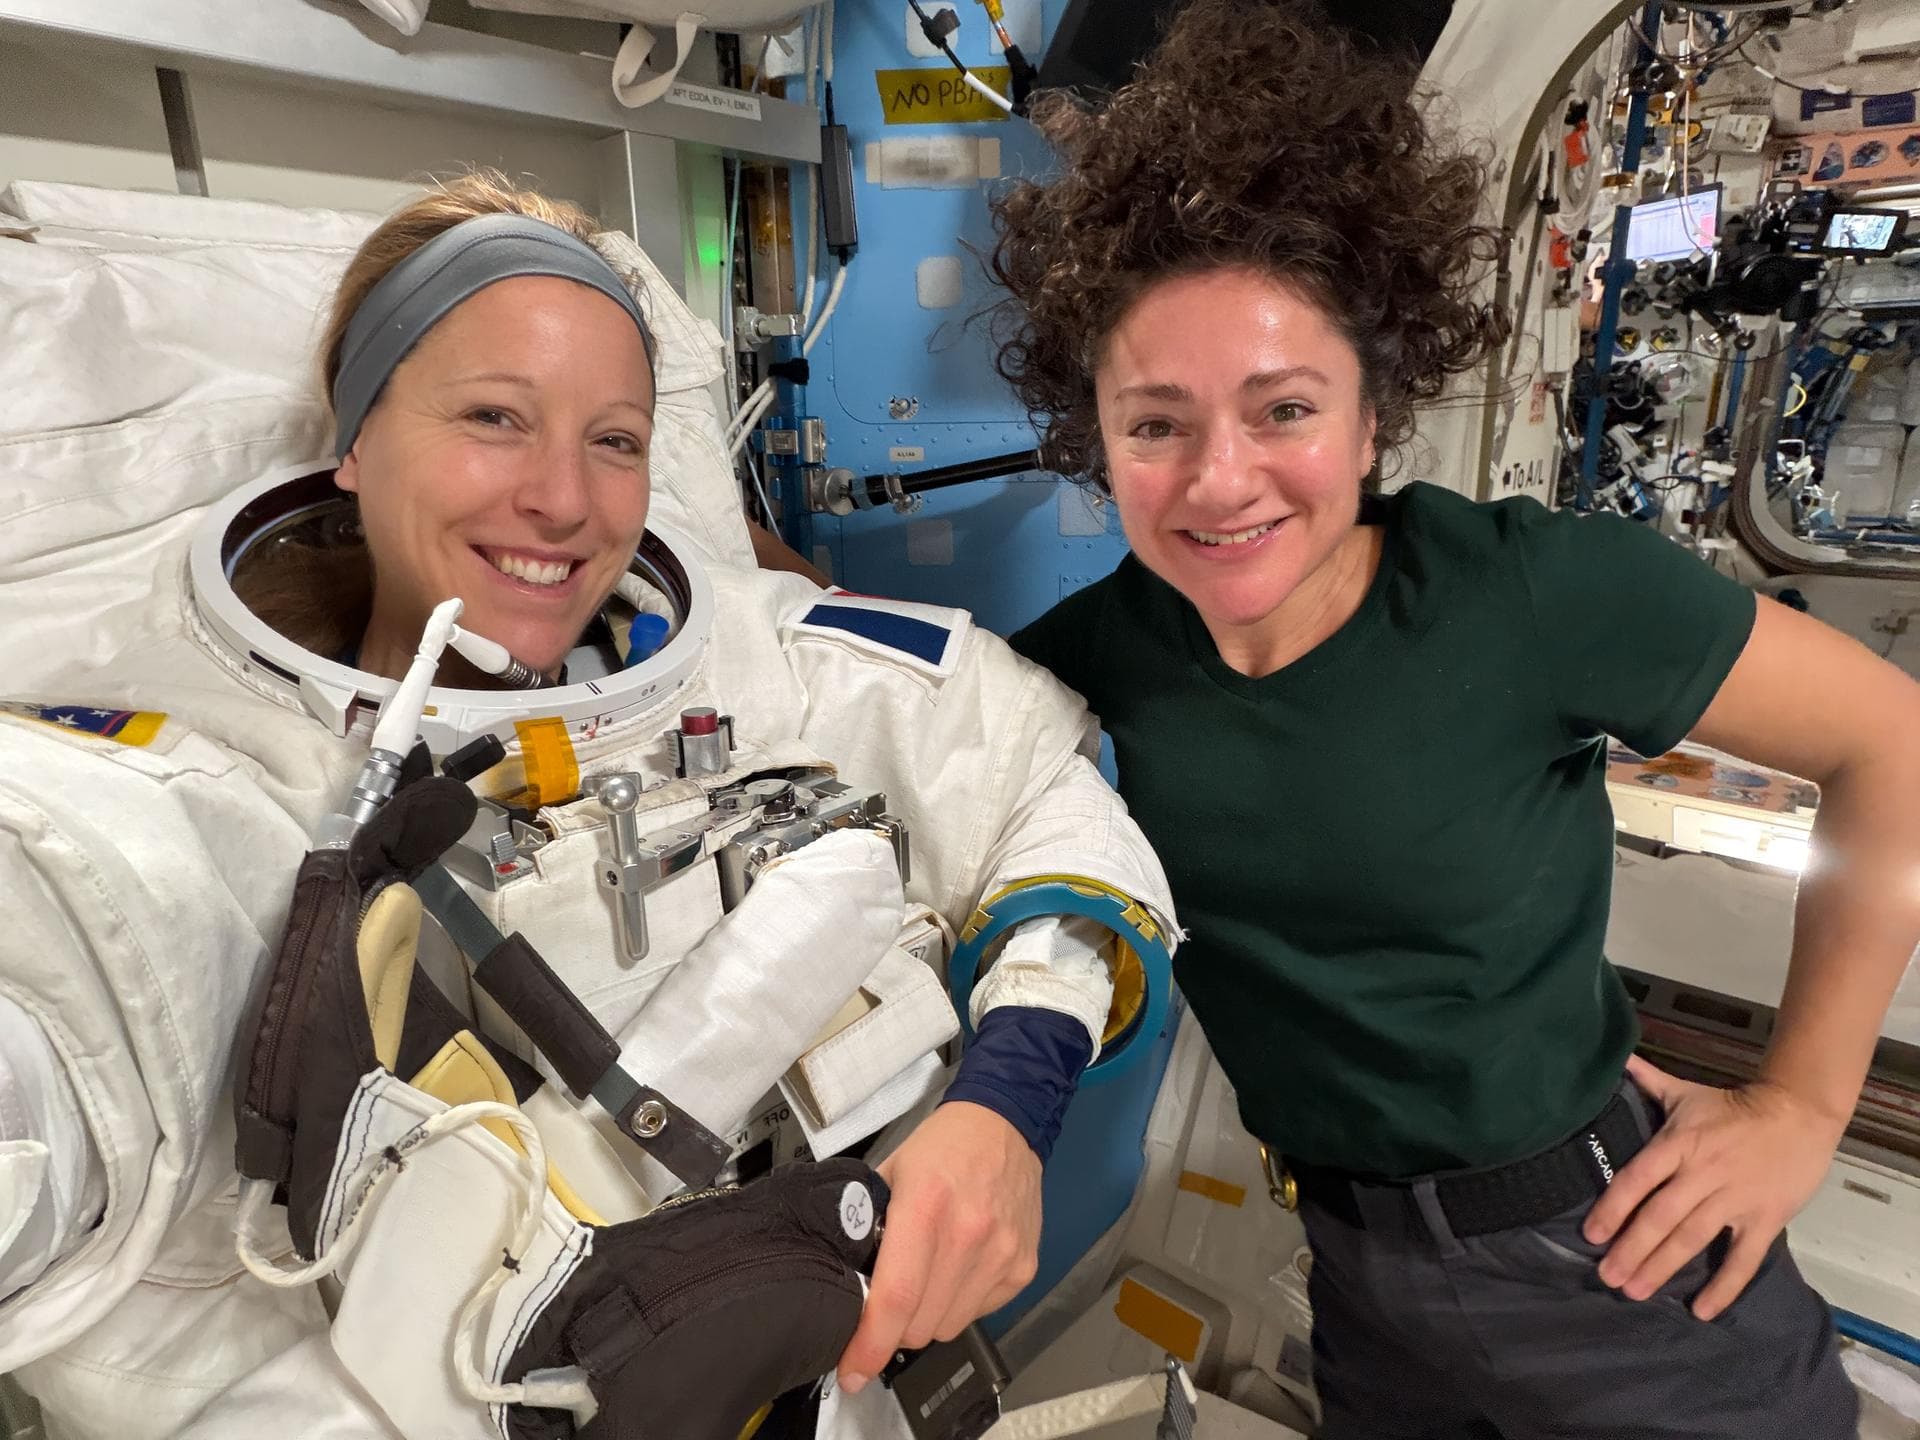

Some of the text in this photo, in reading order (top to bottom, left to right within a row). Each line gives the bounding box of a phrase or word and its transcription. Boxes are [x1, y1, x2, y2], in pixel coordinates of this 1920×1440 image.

[673, 88, 687, 98] AFT
[892, 82, 930, 112] NO
[1513, 462, 1525, 491] To
[1588, 1140, 1614, 1184] ARCAD
